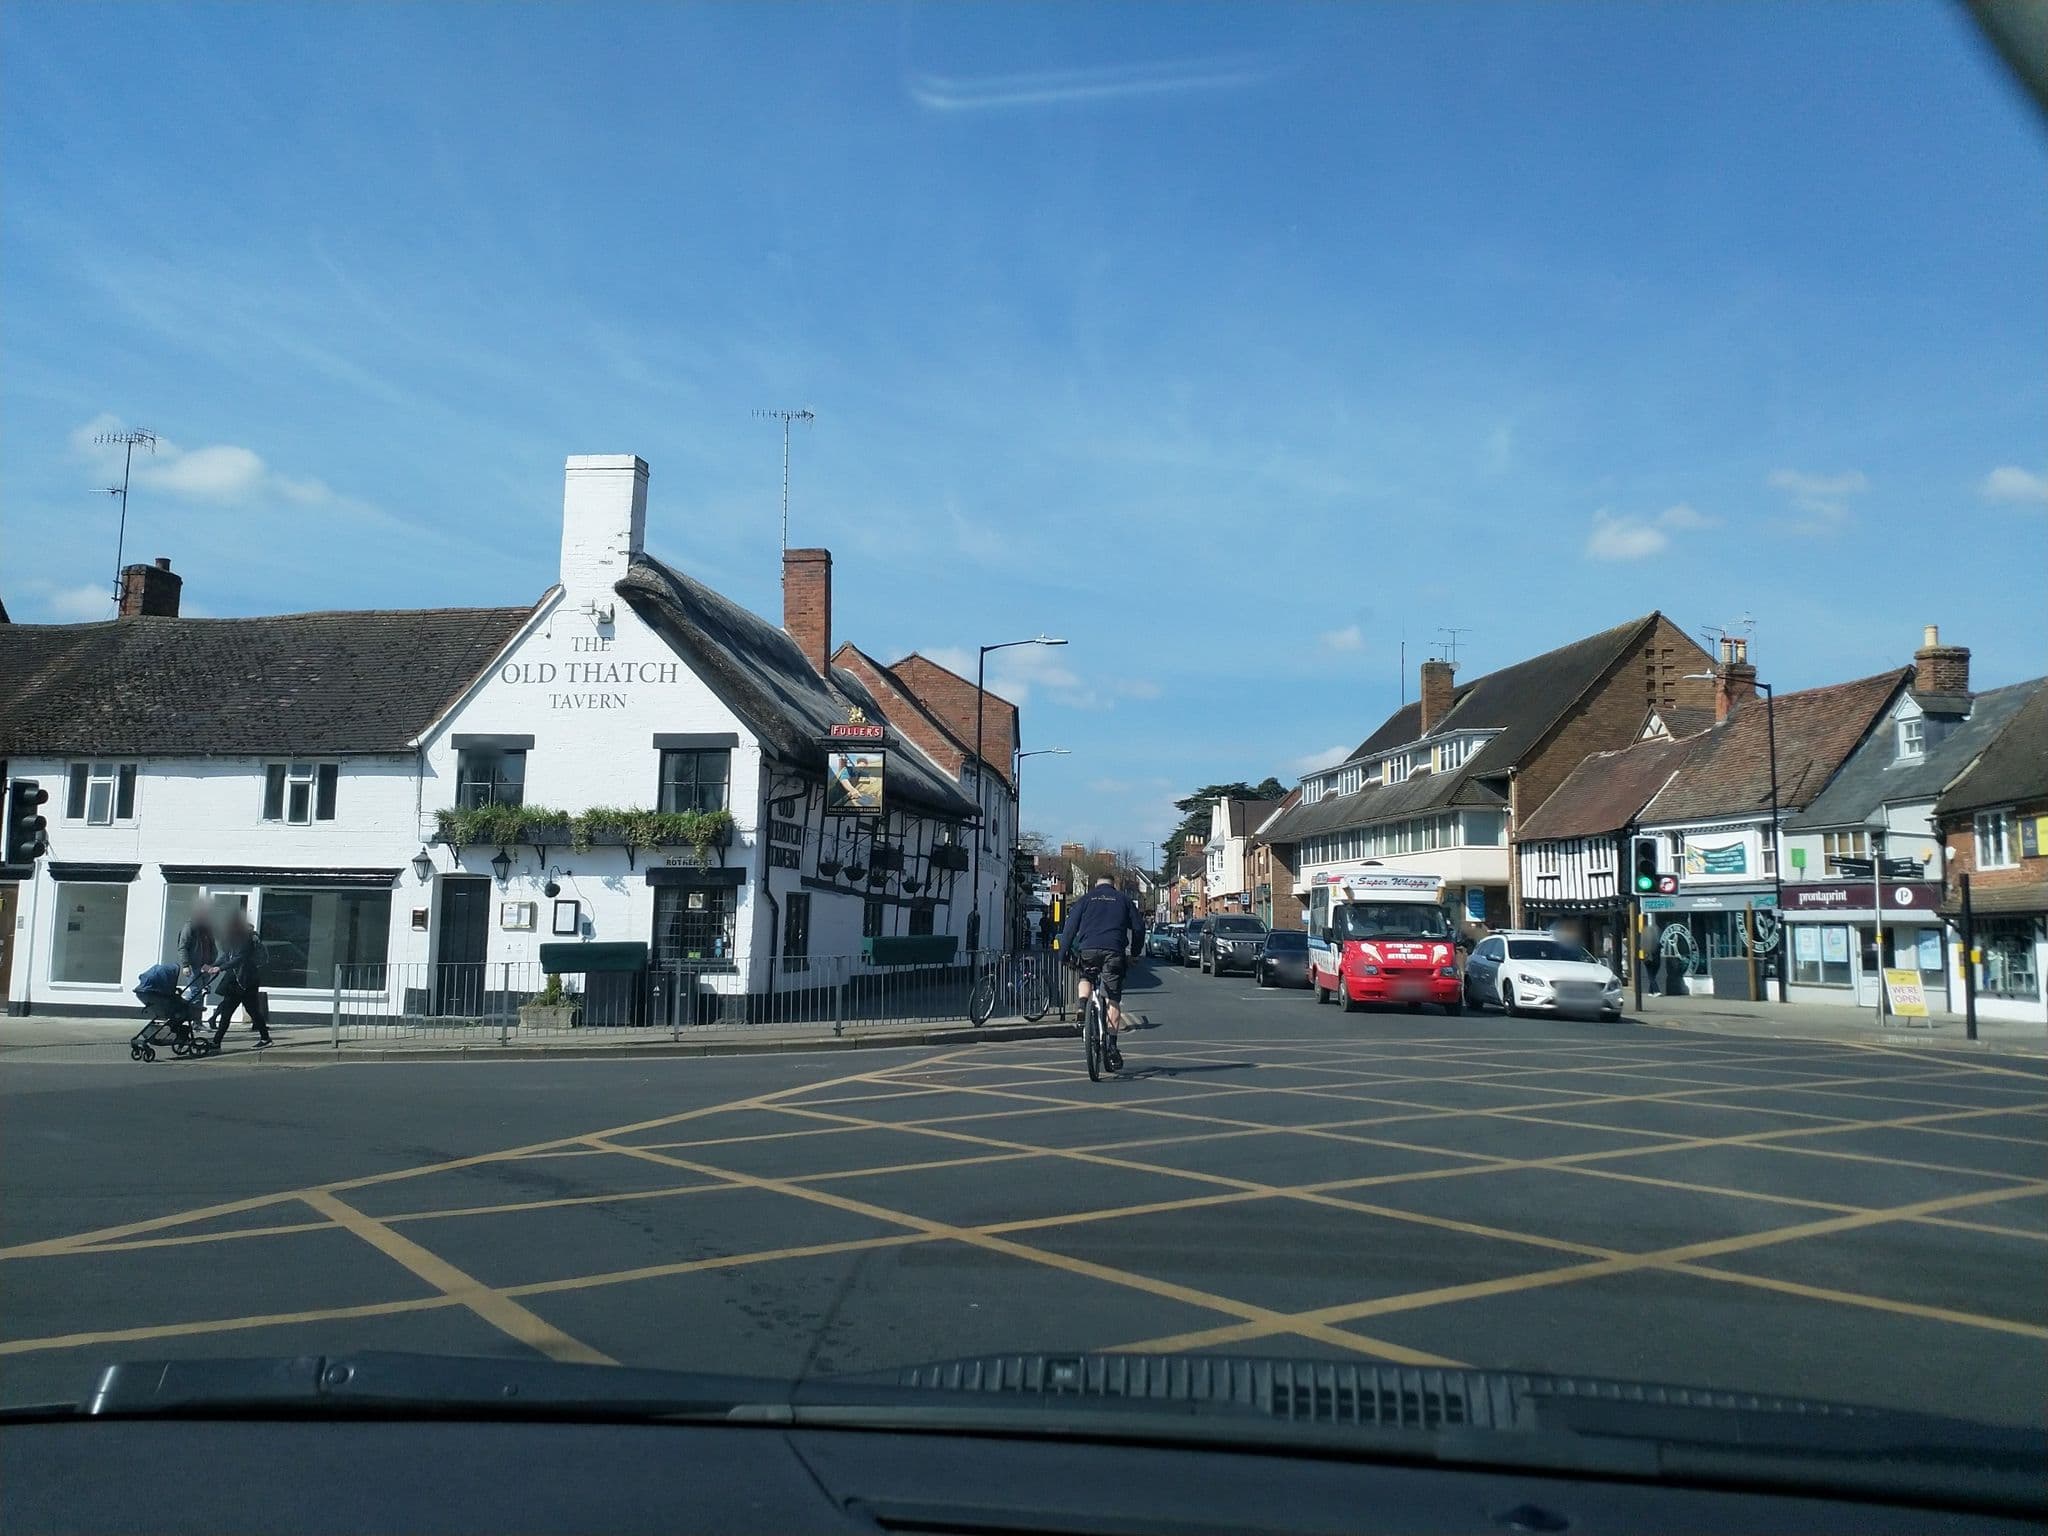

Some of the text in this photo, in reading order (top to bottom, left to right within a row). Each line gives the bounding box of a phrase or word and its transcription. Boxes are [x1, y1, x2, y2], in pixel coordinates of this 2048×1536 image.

[571, 636, 612, 652] THE
[501, 662, 678, 684] OLD THATCH
[548, 693, 628, 710] TAVERN
[1357, 877, 1429, 888] Super Whippy
[1799, 890, 1847, 904] prontaprint
